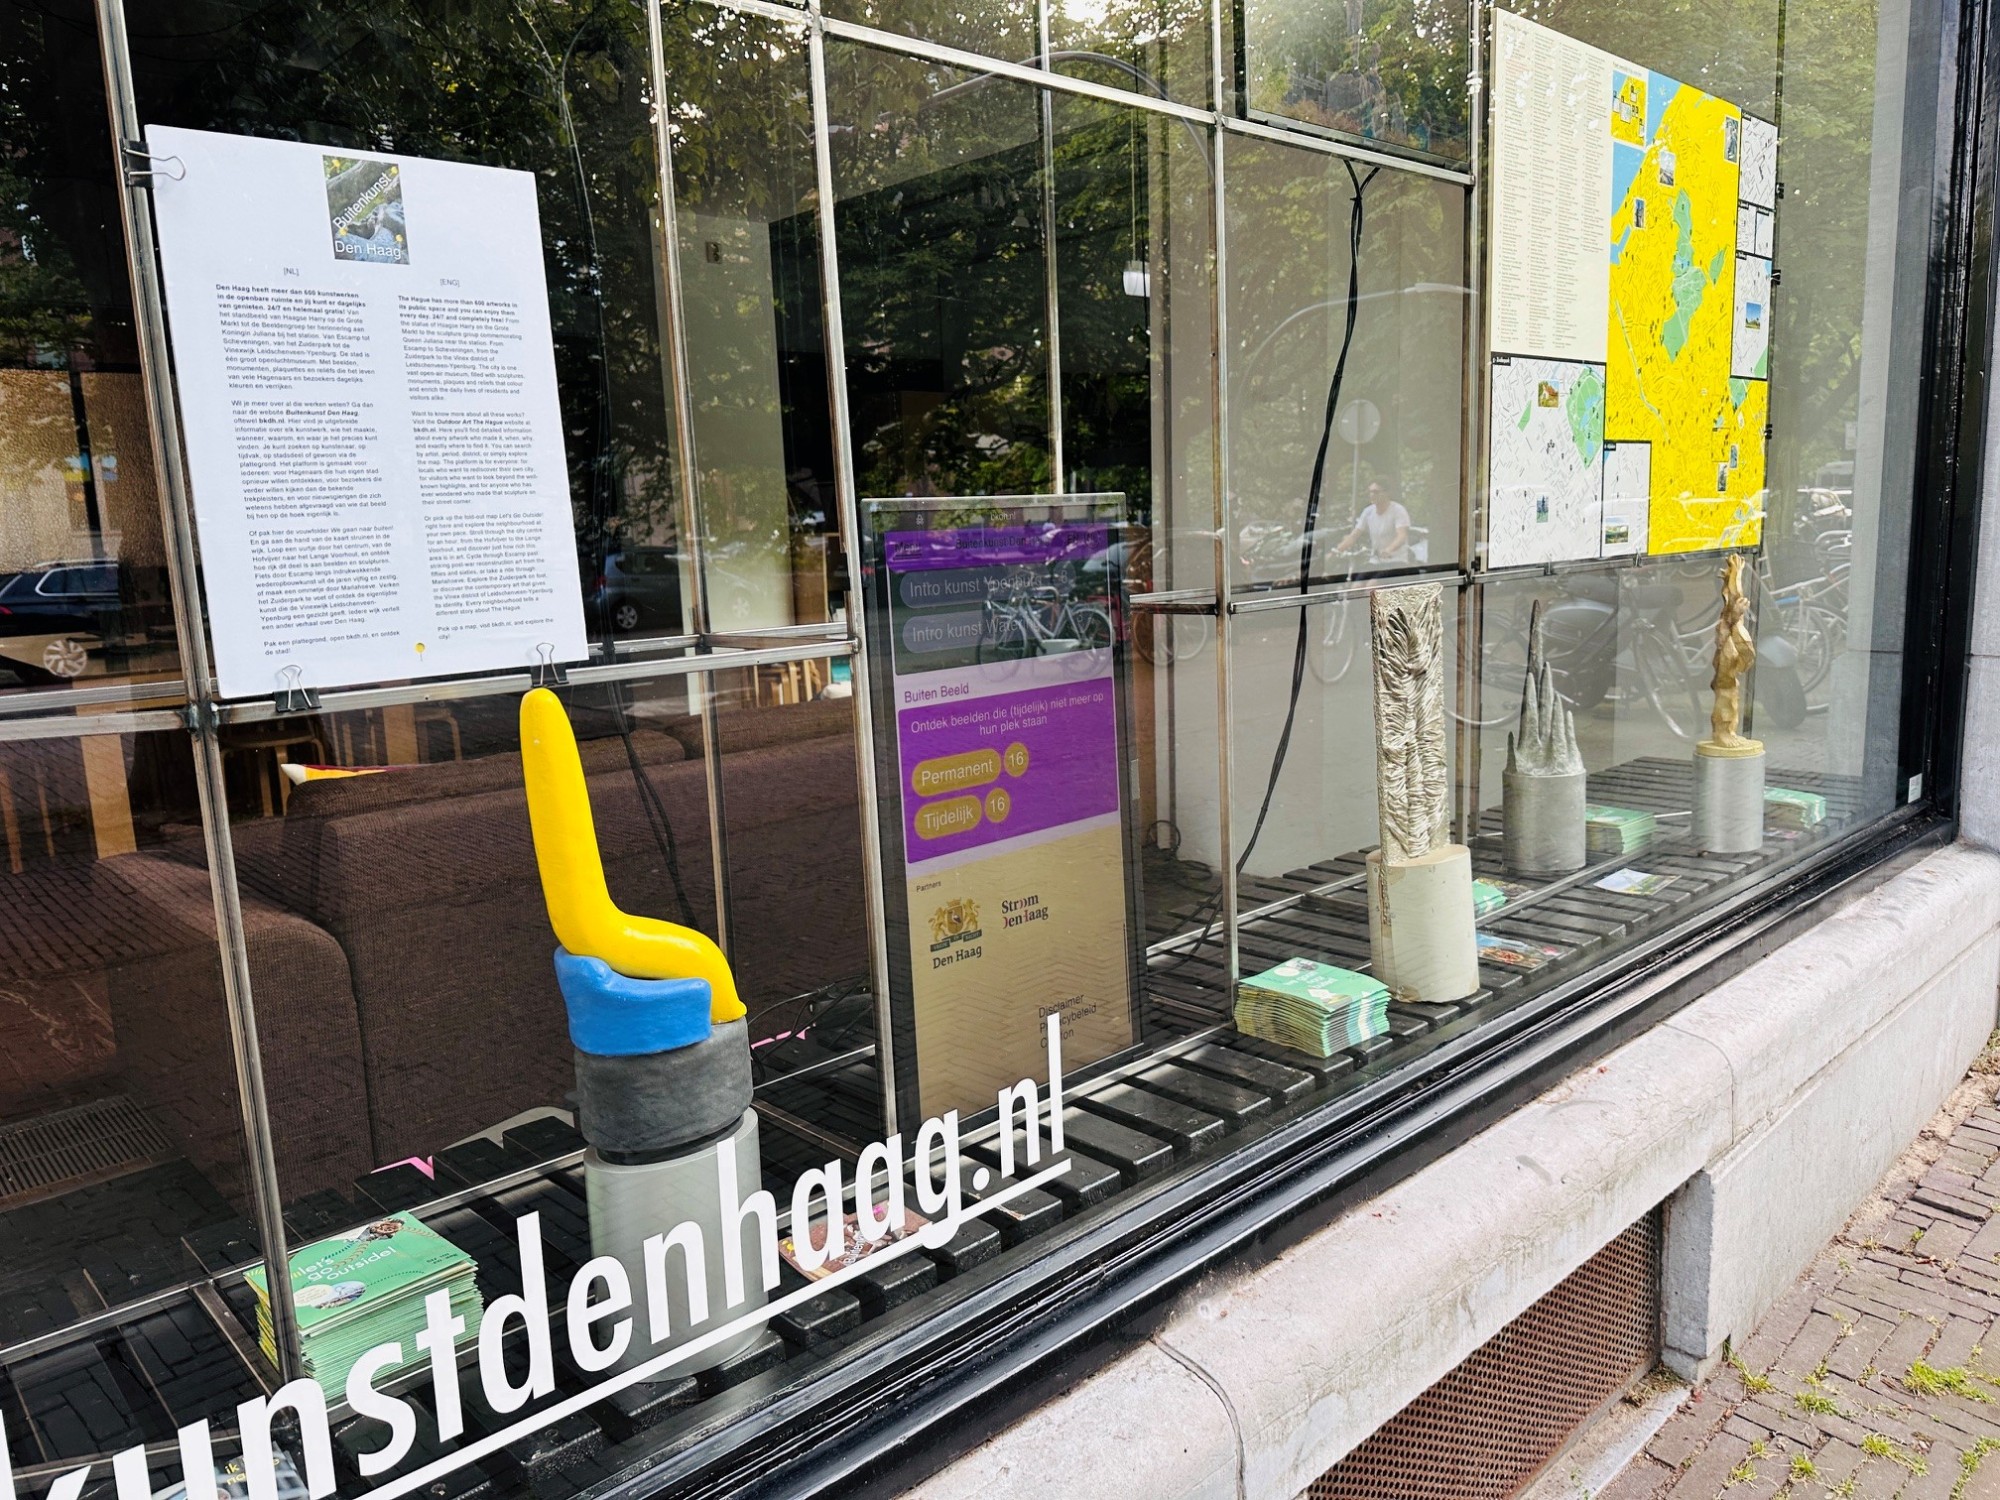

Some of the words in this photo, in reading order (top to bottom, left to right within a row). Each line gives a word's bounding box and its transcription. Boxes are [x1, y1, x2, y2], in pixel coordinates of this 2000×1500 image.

[333, 171, 391, 229] Buitenkunst
[335, 241, 362, 254] Den
[366, 242, 401, 260] Haag
[216, 283, 230, 291] Den
[231, 284, 250, 294] Haag
[251, 285, 269, 293] heeft
[289, 287, 302, 295] dan
[303, 288, 315, 296] 600
[317, 289, 359, 298] kunstwerken
[236, 293, 269, 304] openbare
[270, 295, 292, 303] ruimte
[312, 297, 327, 305] kunt
[337, 299, 365, 309] dagelijks
[909, 580, 941, 598] Intro
[944, 576, 980, 595] kunst
[912, 626, 943, 643] Intro
[947, 621, 982, 639] kunst
[904, 689, 937, 703] Buiten
[941, 682, 970, 697] Beeld
[911, 714, 948, 734] Ontdek
[951, 710, 989, 727] beelden
[993, 706, 1007, 719] die
[1010, 700, 1048, 720] (tijdelijk)
[1051, 697, 1067, 711] niet
[1069, 695, 1091, 707] meer
[1093, 692, 1104, 706] op
[979, 721, 998, 736] hun
[1000, 718, 1020, 735] plek
[1022, 715, 1048, 729] staan
[921, 760, 993, 786] Permanent
[1009, 751, 1024, 768] 16
[923, 804, 974, 831] Tijdelijk
[989, 797, 1005, 814] 16
[916, 880, 942, 893] Partners
[932, 955, 954, 970] Den
[955, 946, 982, 962] Haag
[1038, 994, 1085, 1019] Disclaimer
[299, 1256, 334, 1275] let's
[307, 1268, 333, 1281] go
[225, 1463, 240, 1475] ik
